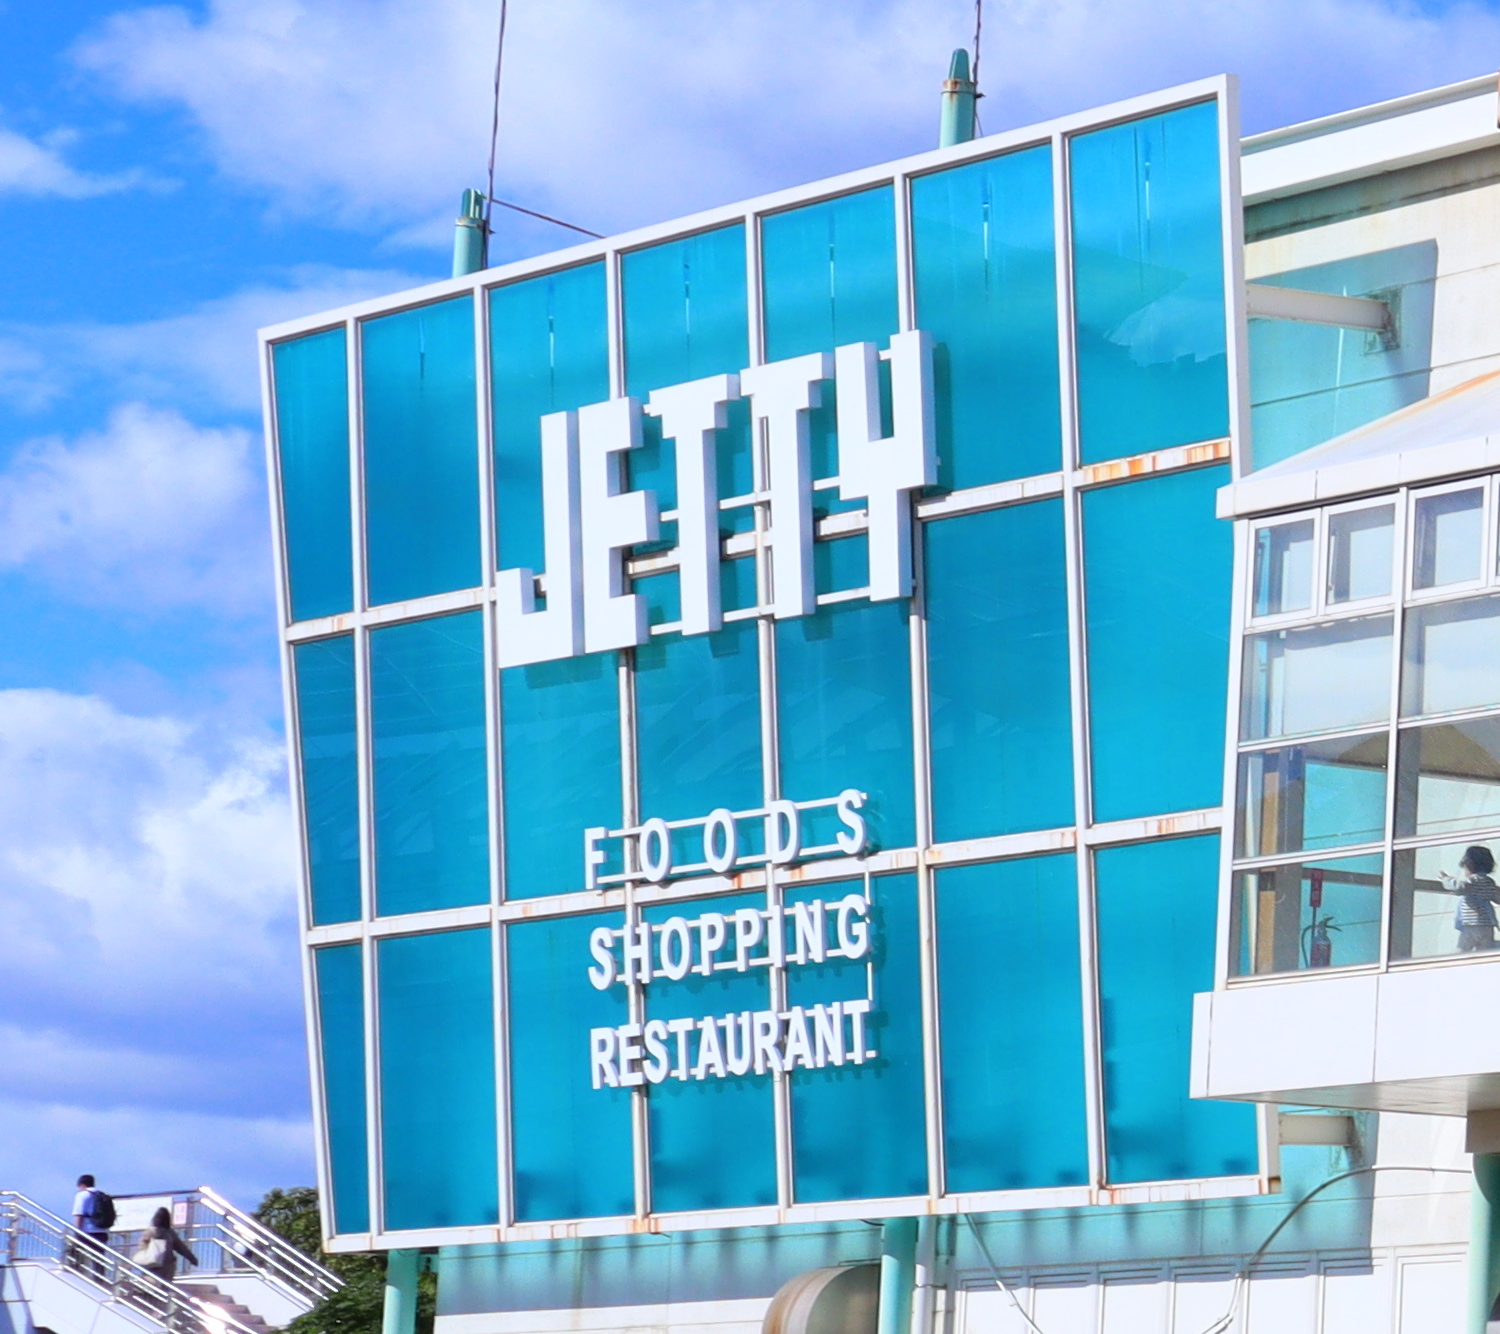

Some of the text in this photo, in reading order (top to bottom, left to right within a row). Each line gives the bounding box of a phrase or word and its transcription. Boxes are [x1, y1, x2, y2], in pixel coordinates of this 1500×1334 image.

[495, 330, 937, 668] JETTY
[584, 789, 866, 889] FOODS
[588, 894, 871, 990] SHOPPING
[590, 1000, 872, 1089] RESTAURANT
